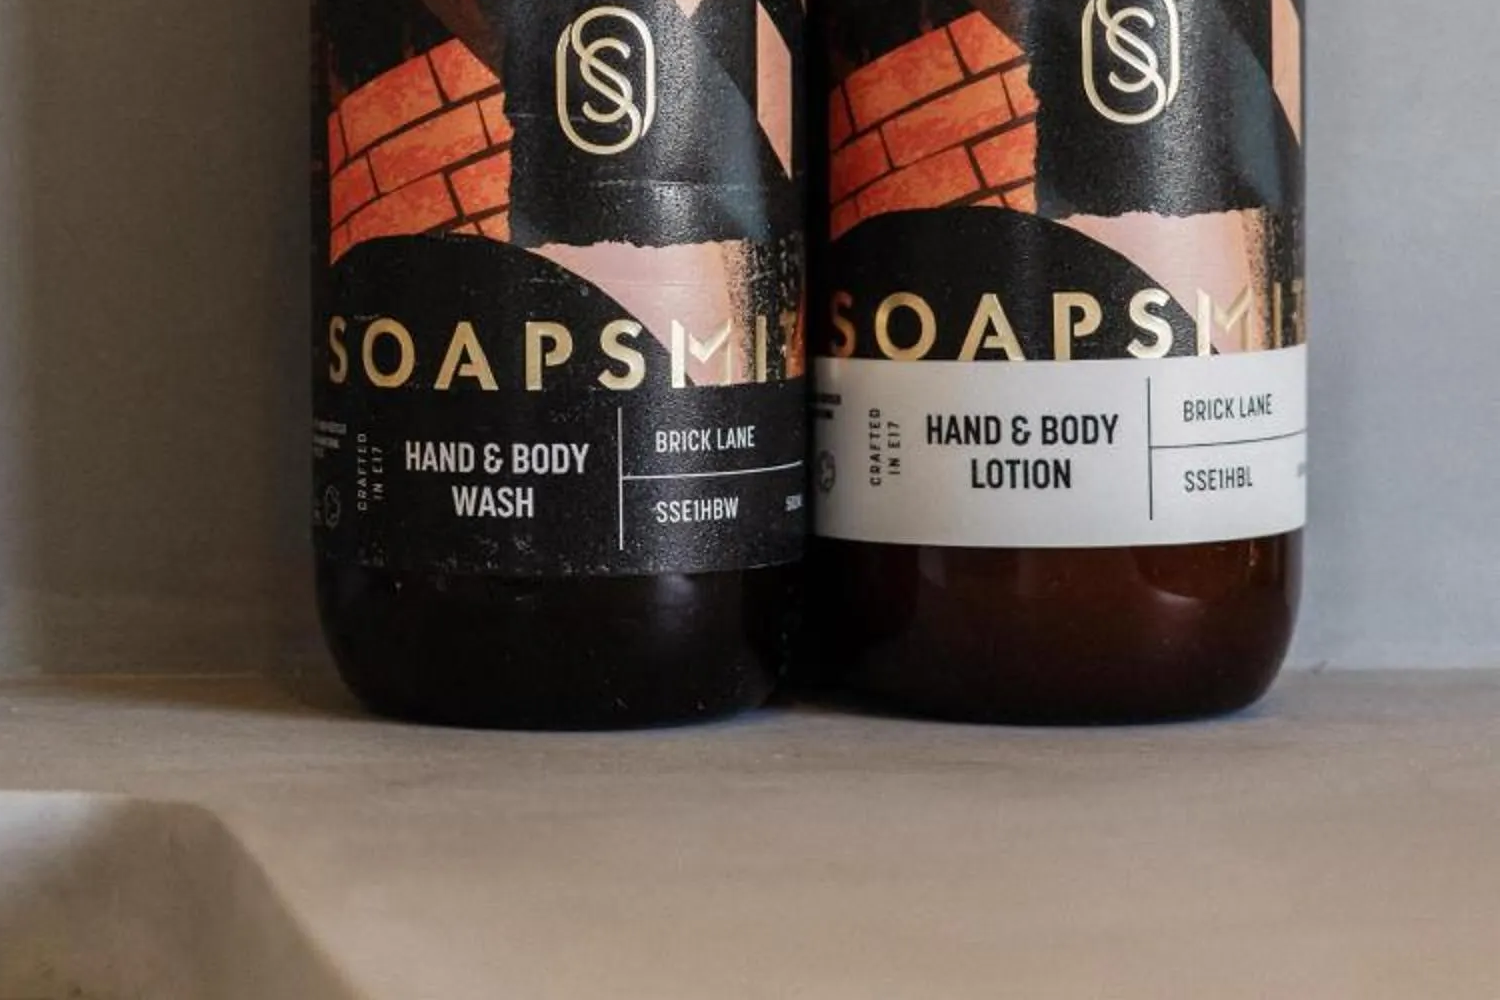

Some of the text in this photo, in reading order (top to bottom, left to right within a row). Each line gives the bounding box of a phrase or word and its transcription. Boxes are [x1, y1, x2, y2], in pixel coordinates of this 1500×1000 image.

[1183, 393, 1273, 422] BRICK LANE
[655, 425, 756, 453] BRICK LANE
[926, 414, 1119, 445] HAND & BODY
[405, 440, 590, 474] HAND & BODY
[868, 408, 881, 487] CRAFTED
[887, 458, 901, 475] IN
[970, 459, 1072, 489] LOTION
[451, 486, 535, 518] WASH
